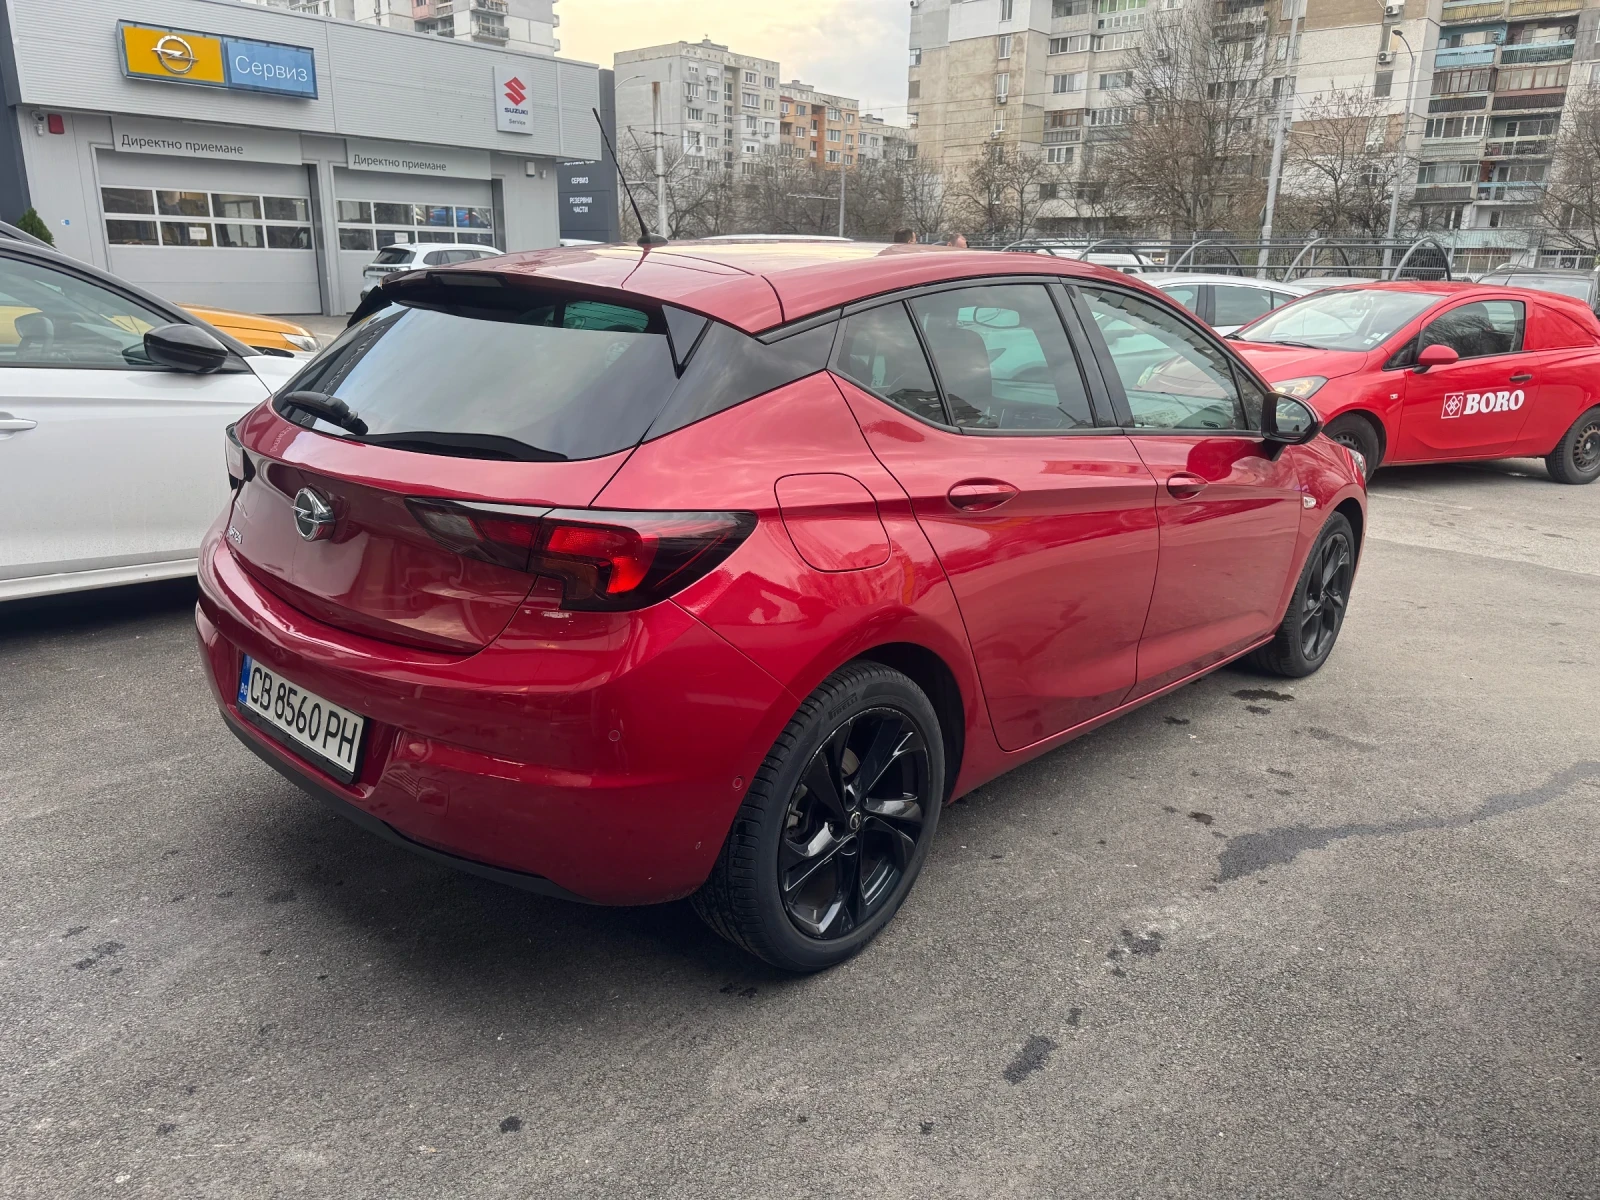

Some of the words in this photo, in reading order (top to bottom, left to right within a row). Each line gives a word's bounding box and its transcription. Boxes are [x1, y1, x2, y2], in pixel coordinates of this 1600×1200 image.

[235, 55, 308, 81] Сервиз
[504, 107, 528, 115] SUZUKI
[121, 134, 182, 149] Директно
[185, 141, 244, 154] приемане
[353, 154, 400, 167] Директно
[402, 159, 447, 171] приемане
[569, 196, 593, 204] РЕЗЕРВНИ
[1463, 389, 1525, 415] BORO
[250, 666, 273, 711] CB
[275, 682, 322, 742] 8560
[322, 709, 358, 764] PH
[828, 692, 858, 720] PIRELLI
